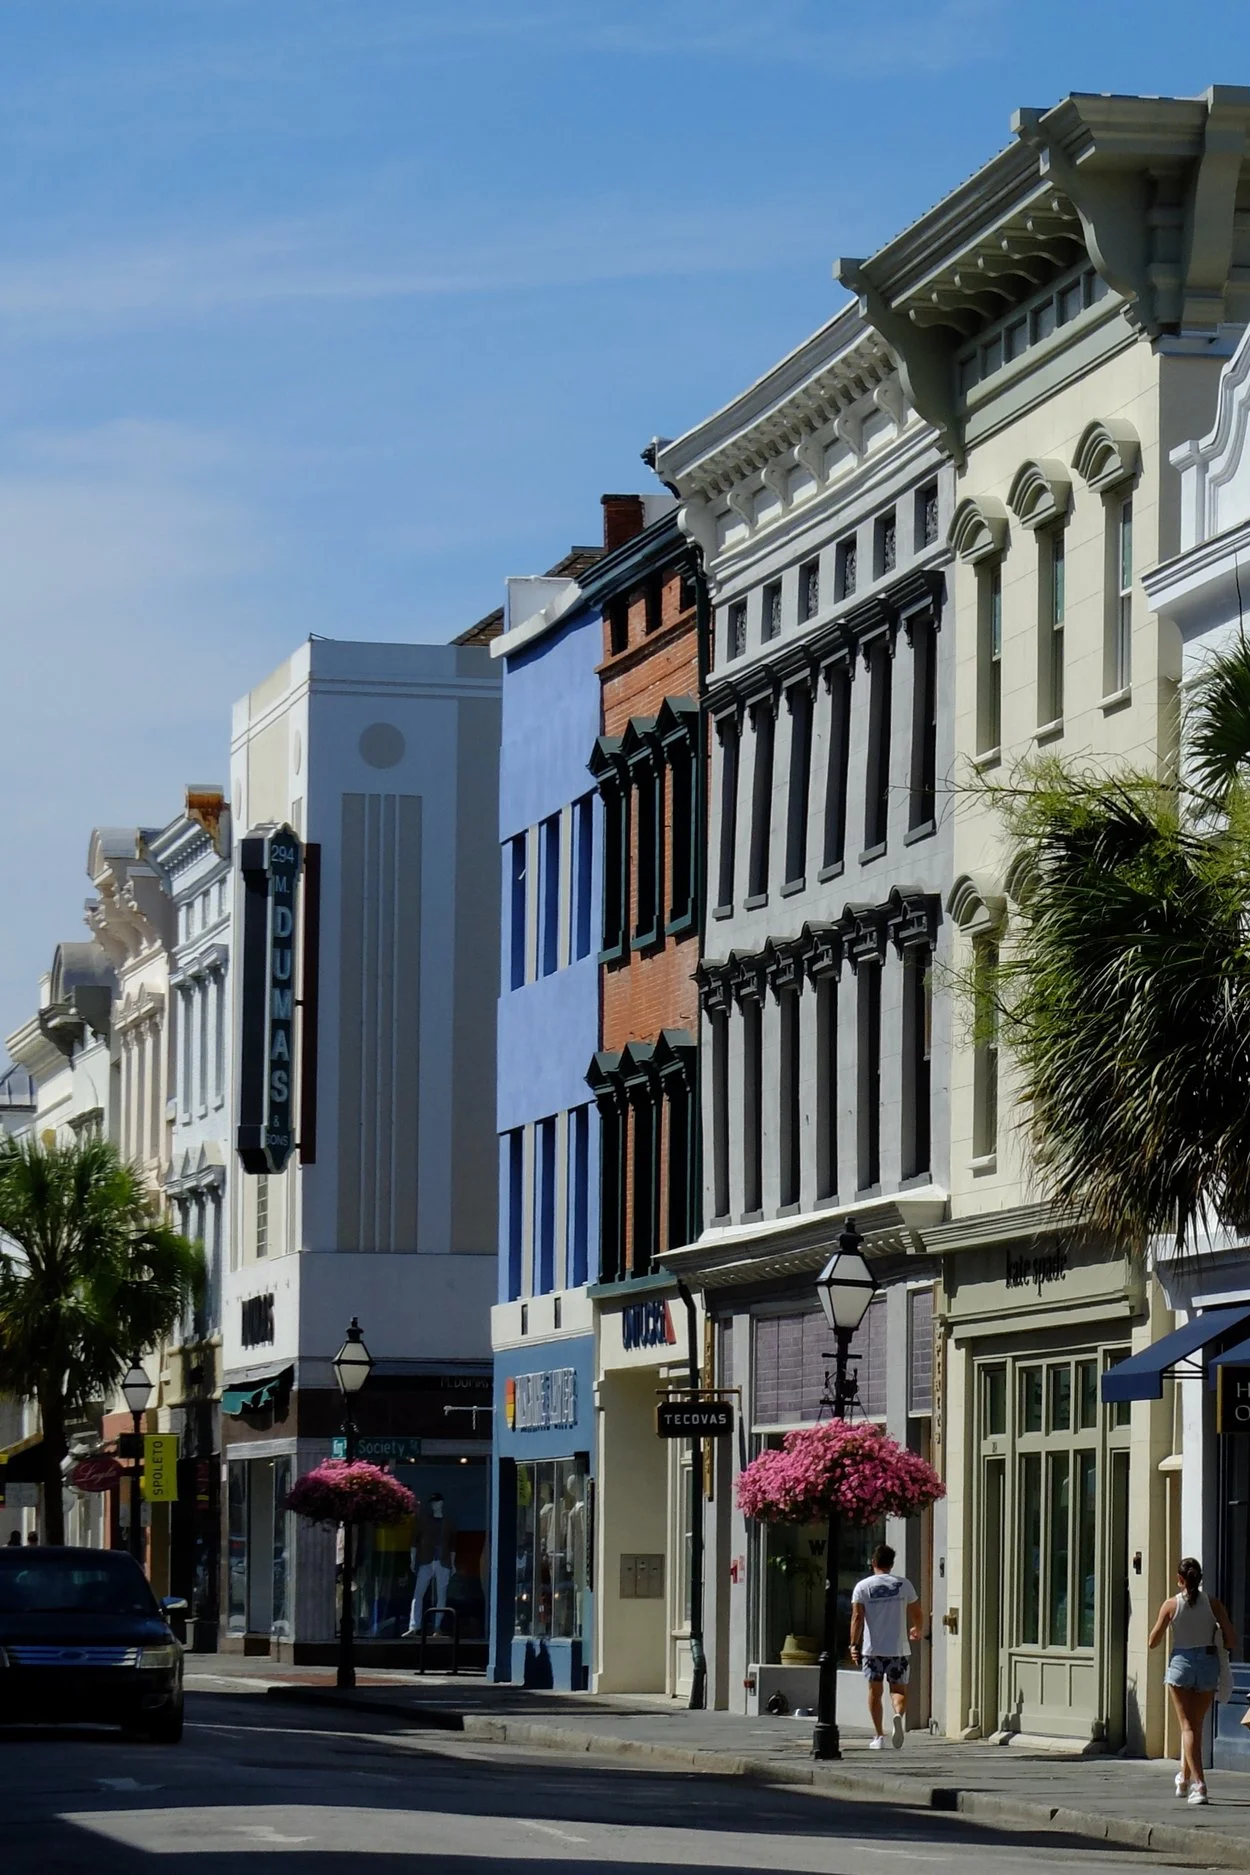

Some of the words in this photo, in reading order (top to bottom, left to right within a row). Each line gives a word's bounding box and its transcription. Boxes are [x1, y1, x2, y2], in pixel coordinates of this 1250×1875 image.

[271, 845, 294, 863] 294
[271, 905, 293, 1103] DUMAS
[664, 1414, 727, 1424] TECOVAS
[358, 1438, 406, 1456] Society
[152, 1440, 164, 1496] SPOLETO
[808, 1540, 827, 1555] W
